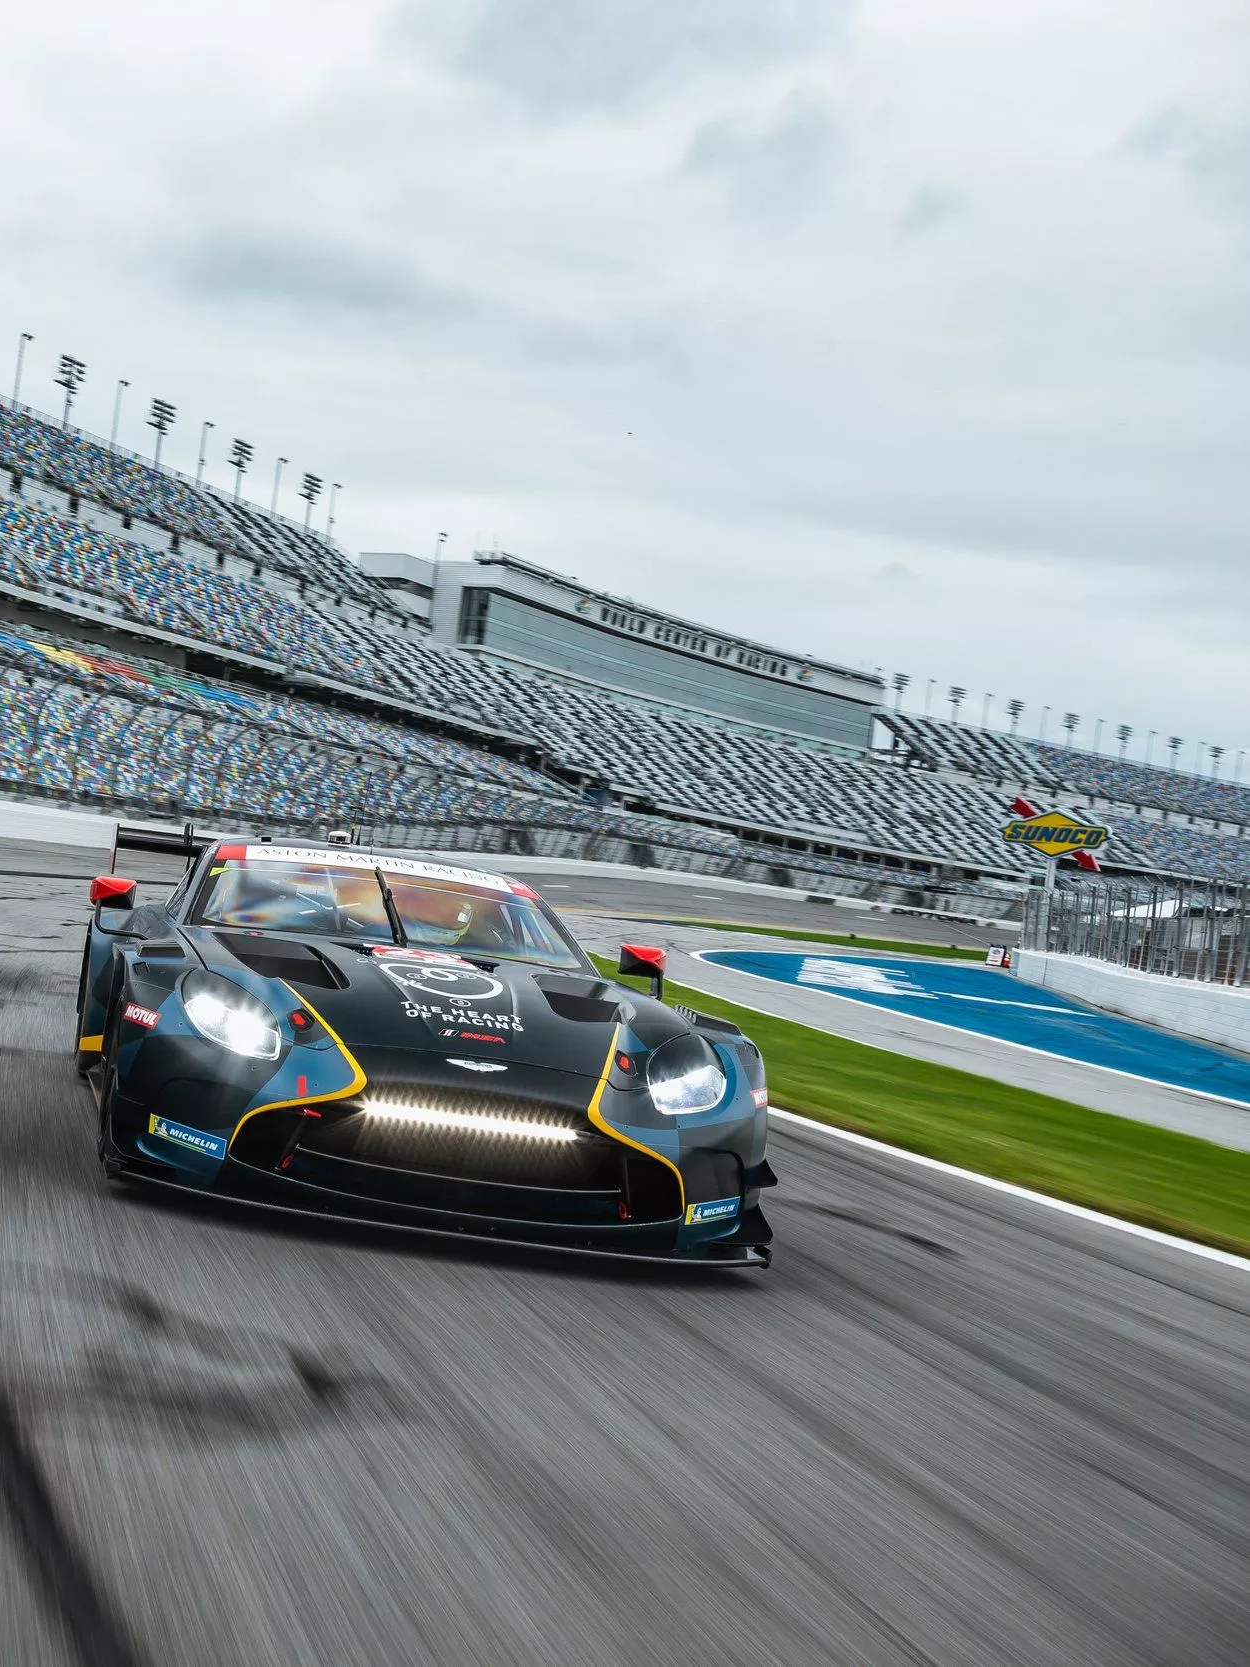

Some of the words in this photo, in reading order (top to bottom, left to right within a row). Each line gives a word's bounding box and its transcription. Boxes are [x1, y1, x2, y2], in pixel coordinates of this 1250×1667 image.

[1007, 823, 1103, 846] SUNOCO
[257, 848, 327, 859] ASTON
[336, 853, 415, 870] MARTIN
[423, 864, 500, 885] RACING
[125, 1005, 158, 1026] MOTUL
[401, 1001, 443, 1014] THE
[451, 1008, 522, 1024] HEART
[405, 1009, 432, 1019] OF
[443, 1014, 524, 1032] RACING
[459, 1031, 507, 1044] IMSA
[169, 1128, 219, 1151] MICHELIN
[702, 1204, 736, 1217] MICHELIN
